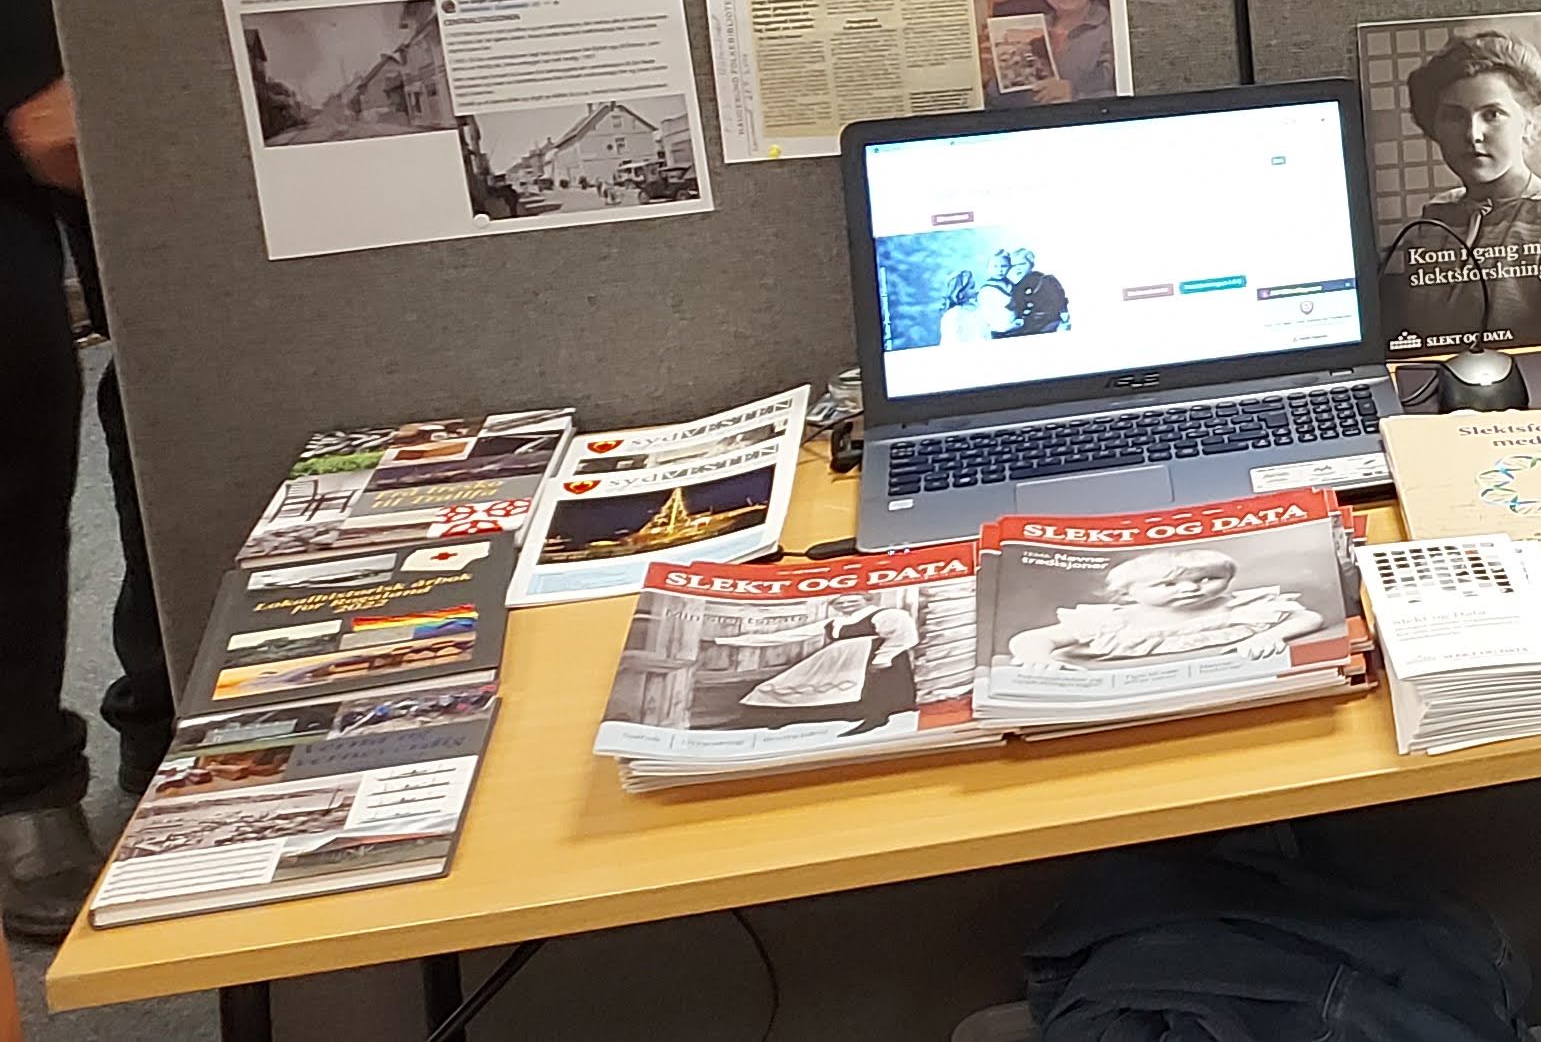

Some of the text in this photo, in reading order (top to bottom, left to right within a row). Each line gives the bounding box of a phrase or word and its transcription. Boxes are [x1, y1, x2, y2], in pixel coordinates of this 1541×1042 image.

[1408, 247, 1456, 265] Kom
[1460, 248, 1468, 261] i
[1473, 245, 1519, 263] gang
[1426, 334, 1462, 347] SLEKT
[1483, 329, 1514, 342] DATA
[1022, 504, 1308, 542] SLEKT OG DATA
[665, 558, 969, 594] SLEKT OG DATA
[1022, 557, 1109, 570] tradisjoner
[253, 582, 405, 612] Lokalhistorisk
